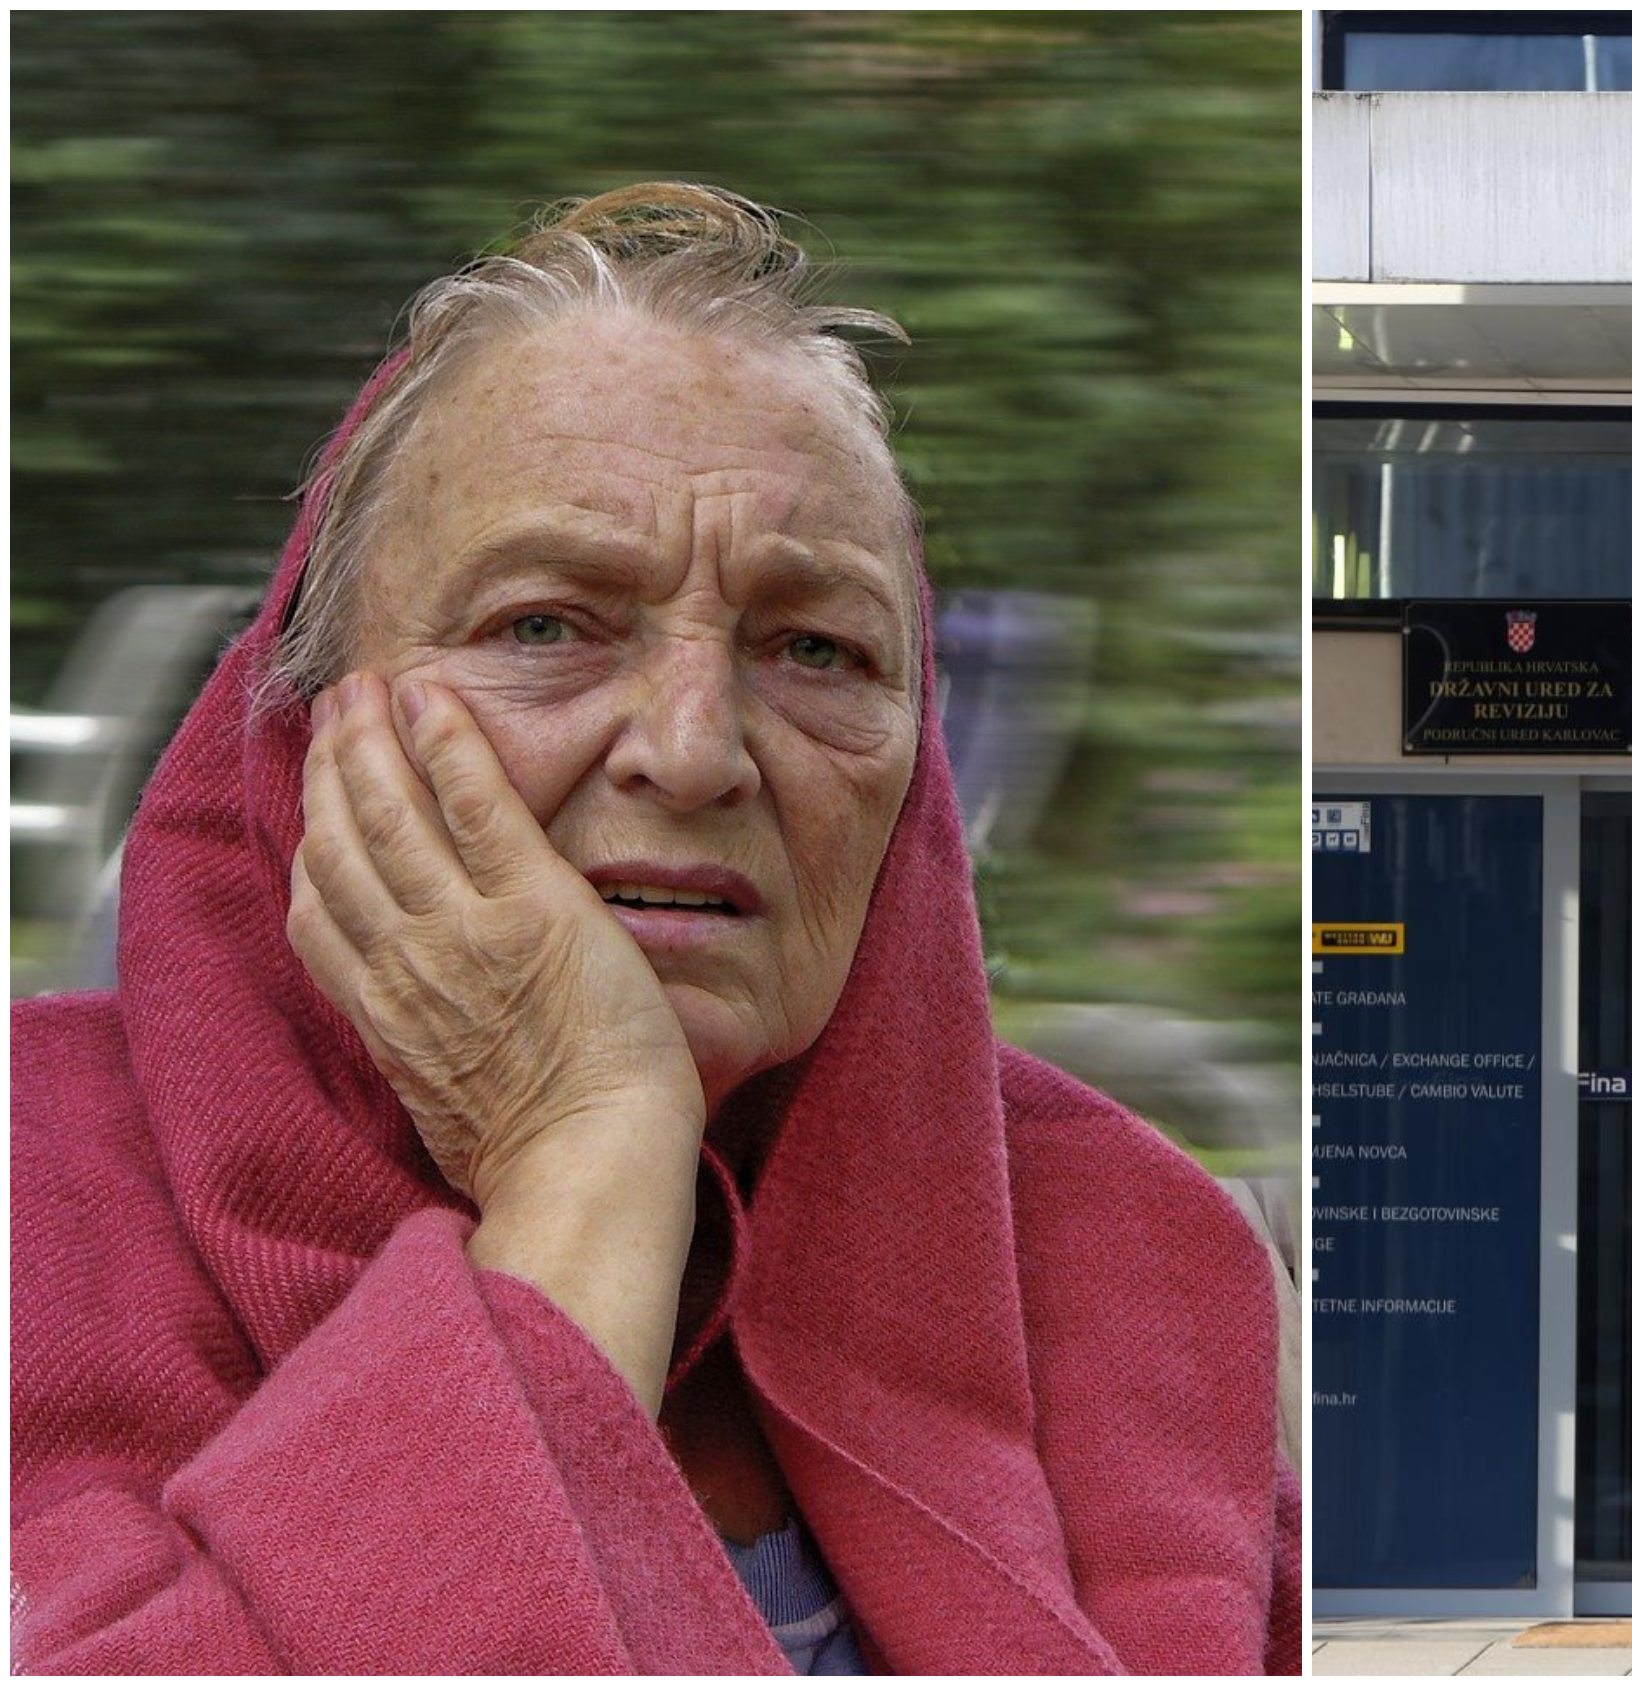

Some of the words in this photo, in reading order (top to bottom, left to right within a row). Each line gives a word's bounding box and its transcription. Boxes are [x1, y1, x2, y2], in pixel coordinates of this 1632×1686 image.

[1444, 660, 1522, 673] REPUBLIKA
[1526, 661, 1600, 673] HRVATSKA
[1429, 679, 1519, 697] DRŽAVNI
[1525, 682, 1581, 698] URED
[1586, 682, 1613, 698] ZA
[1474, 703, 1569, 719] REVIZIJU
[1423, 726, 1495, 741] PODRUČNI
[1499, 729, 1539, 741] URED
[1542, 729, 1620, 742] KARLOVAC
[1393, 1054, 1470, 1068] EXCHANGE
[1474, 1054, 1524, 1069] OFFICE
[1312, 1084, 1395, 1098] HSELSTUBE
[1410, 1085, 1467, 1099] CAMBIO
[1472, 1085, 1523, 1099] VALUTE
[1359, 1146, 1407, 1159] NOVCA
[1382, 1207, 1500, 1221] BEZGOTOVINSKE
[1312, 1237, 1334, 1251] GE
[1312, 1299, 1356, 1313] TETNE
[1361, 1300, 1456, 1314] INFORMACIJE
